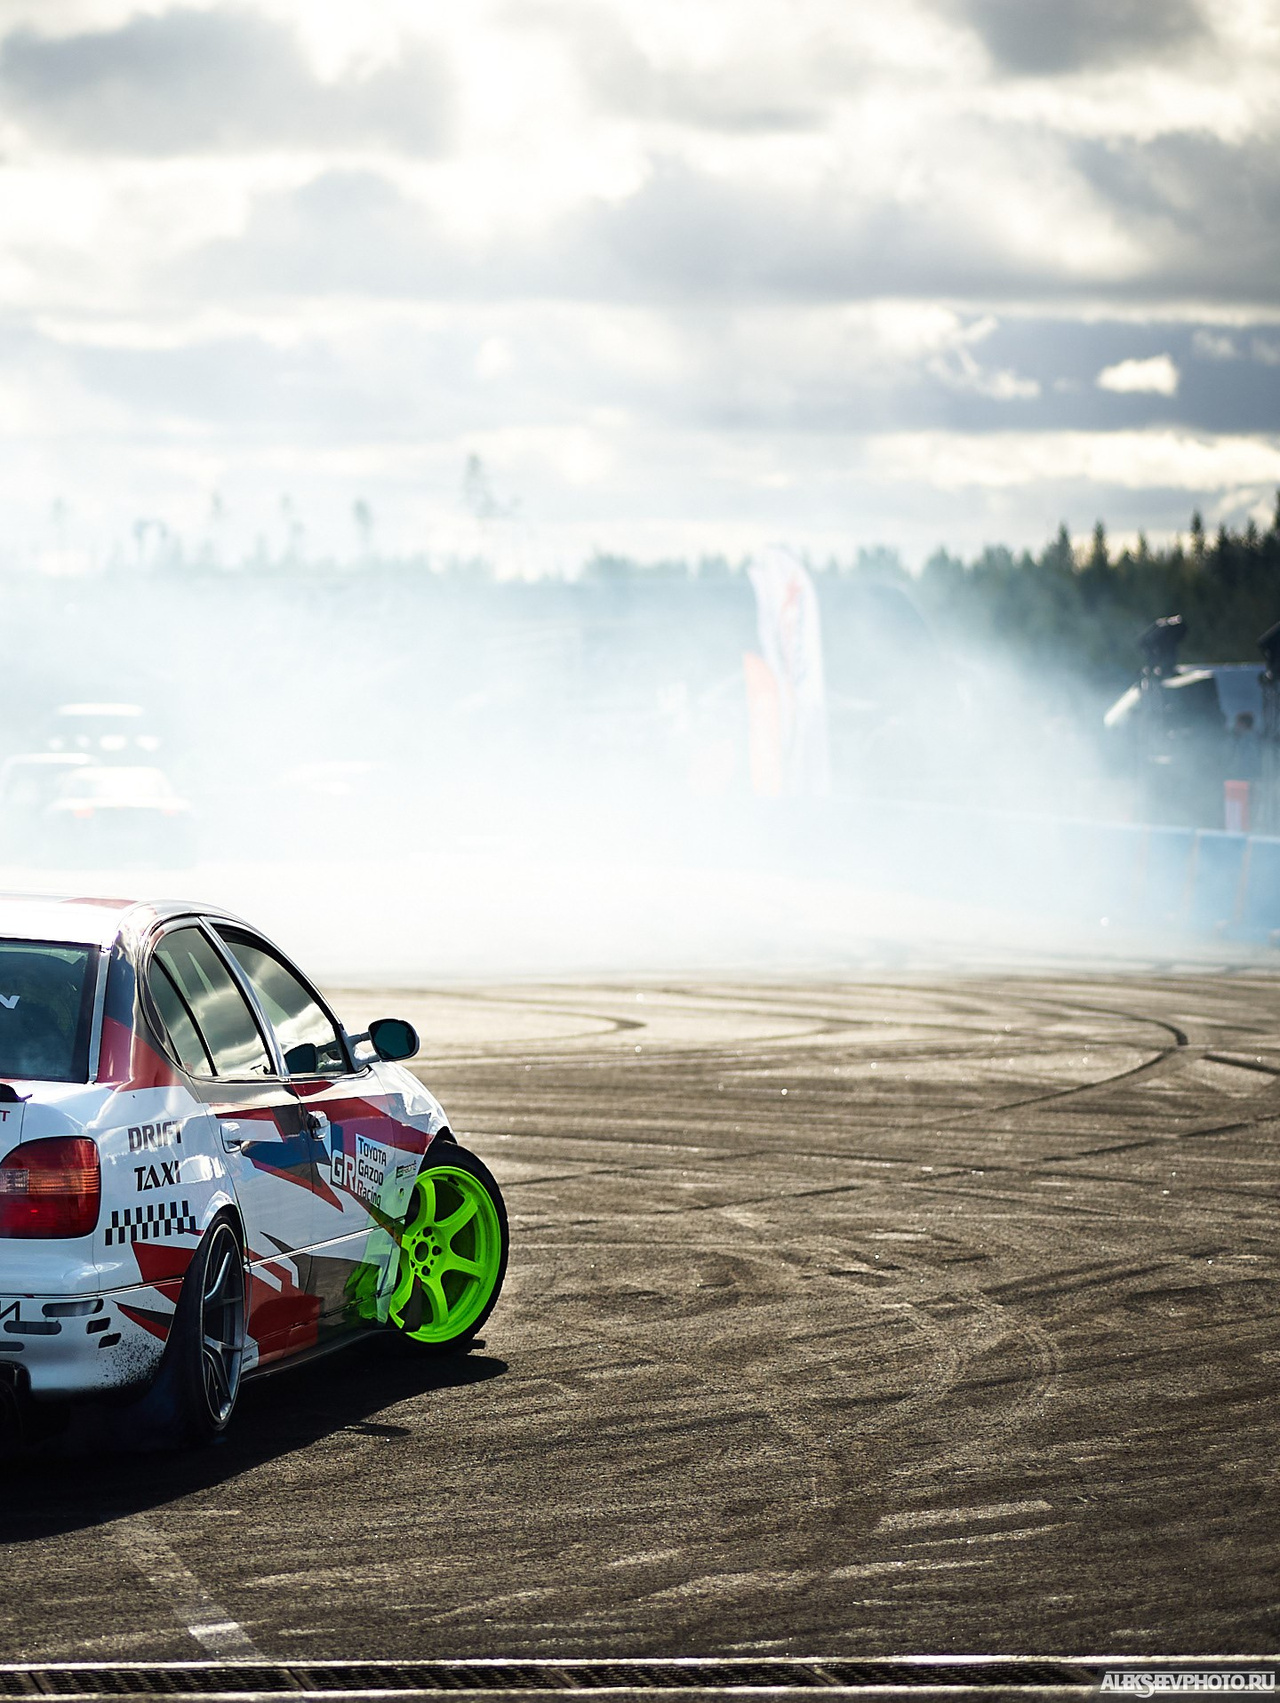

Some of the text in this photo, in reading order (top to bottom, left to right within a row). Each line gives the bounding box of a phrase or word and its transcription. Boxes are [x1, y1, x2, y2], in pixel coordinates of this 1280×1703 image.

[127, 1121, 182, 1152] DRIFT
[358, 1137, 387, 1167] TOYOTA
[134, 1160, 181, 1192] TAXI
[331, 1149, 357, 1194] GR
[358, 1158, 384, 1187] GAZOO
